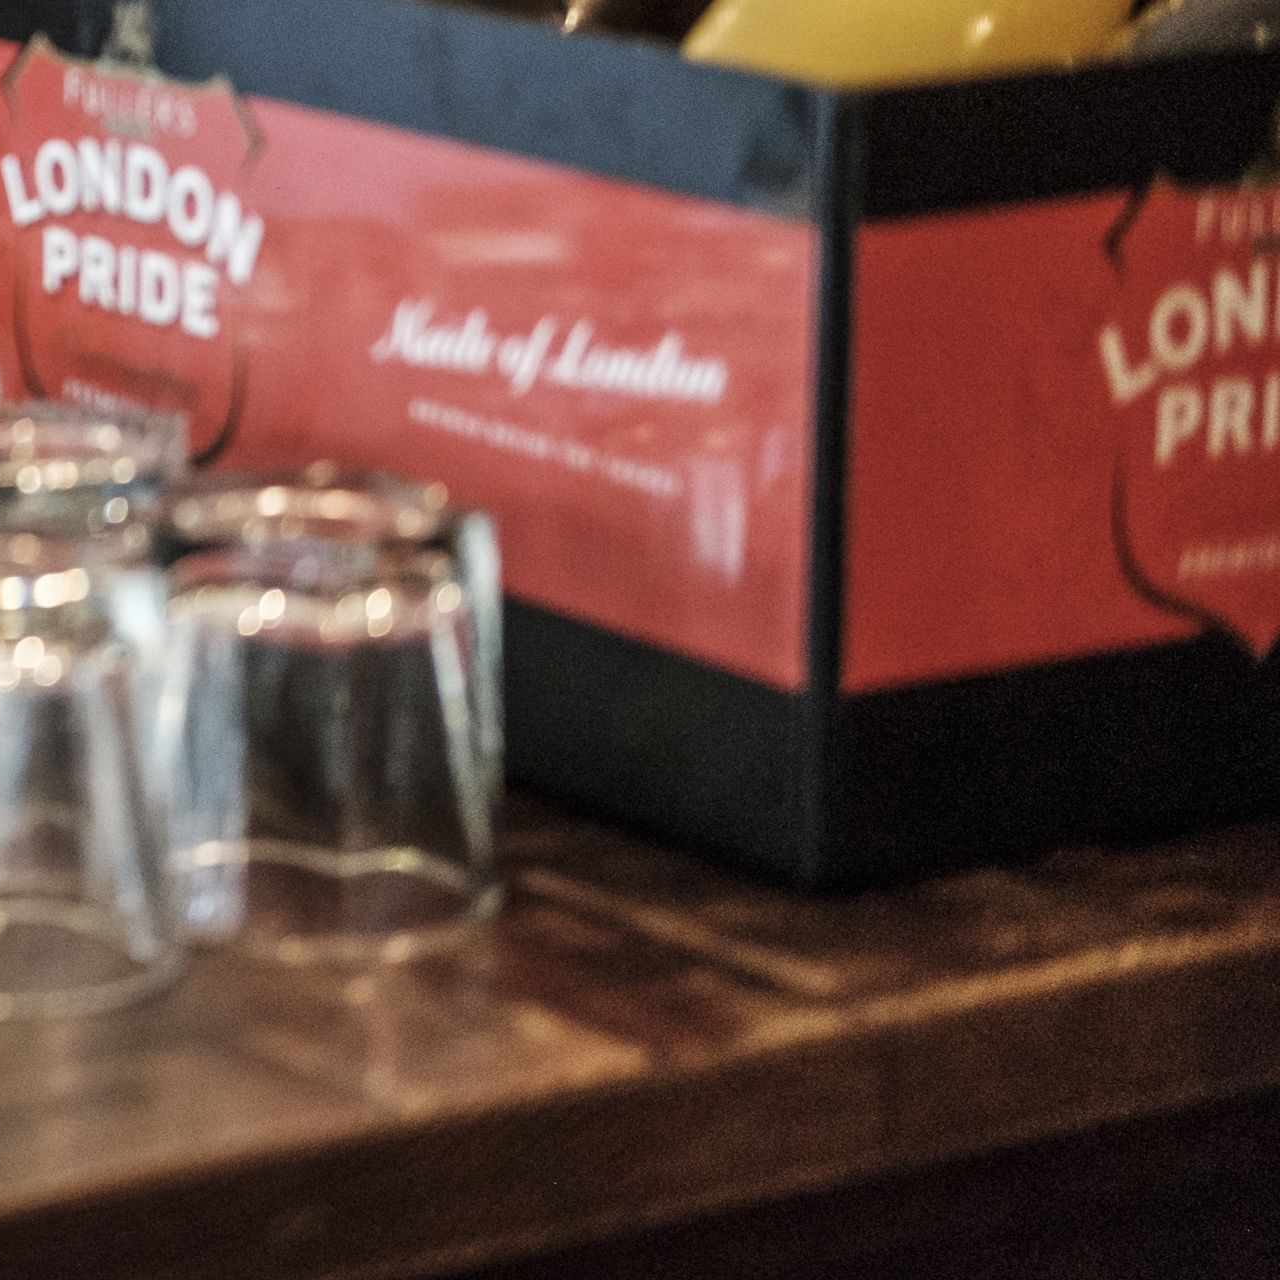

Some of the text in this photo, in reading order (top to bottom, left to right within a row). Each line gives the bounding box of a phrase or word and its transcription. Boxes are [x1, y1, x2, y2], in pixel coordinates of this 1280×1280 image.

[0, 136, 266, 287] LONDON
[42, 224, 221, 339] PRIDE
[1098, 258, 1280, 406] LON
